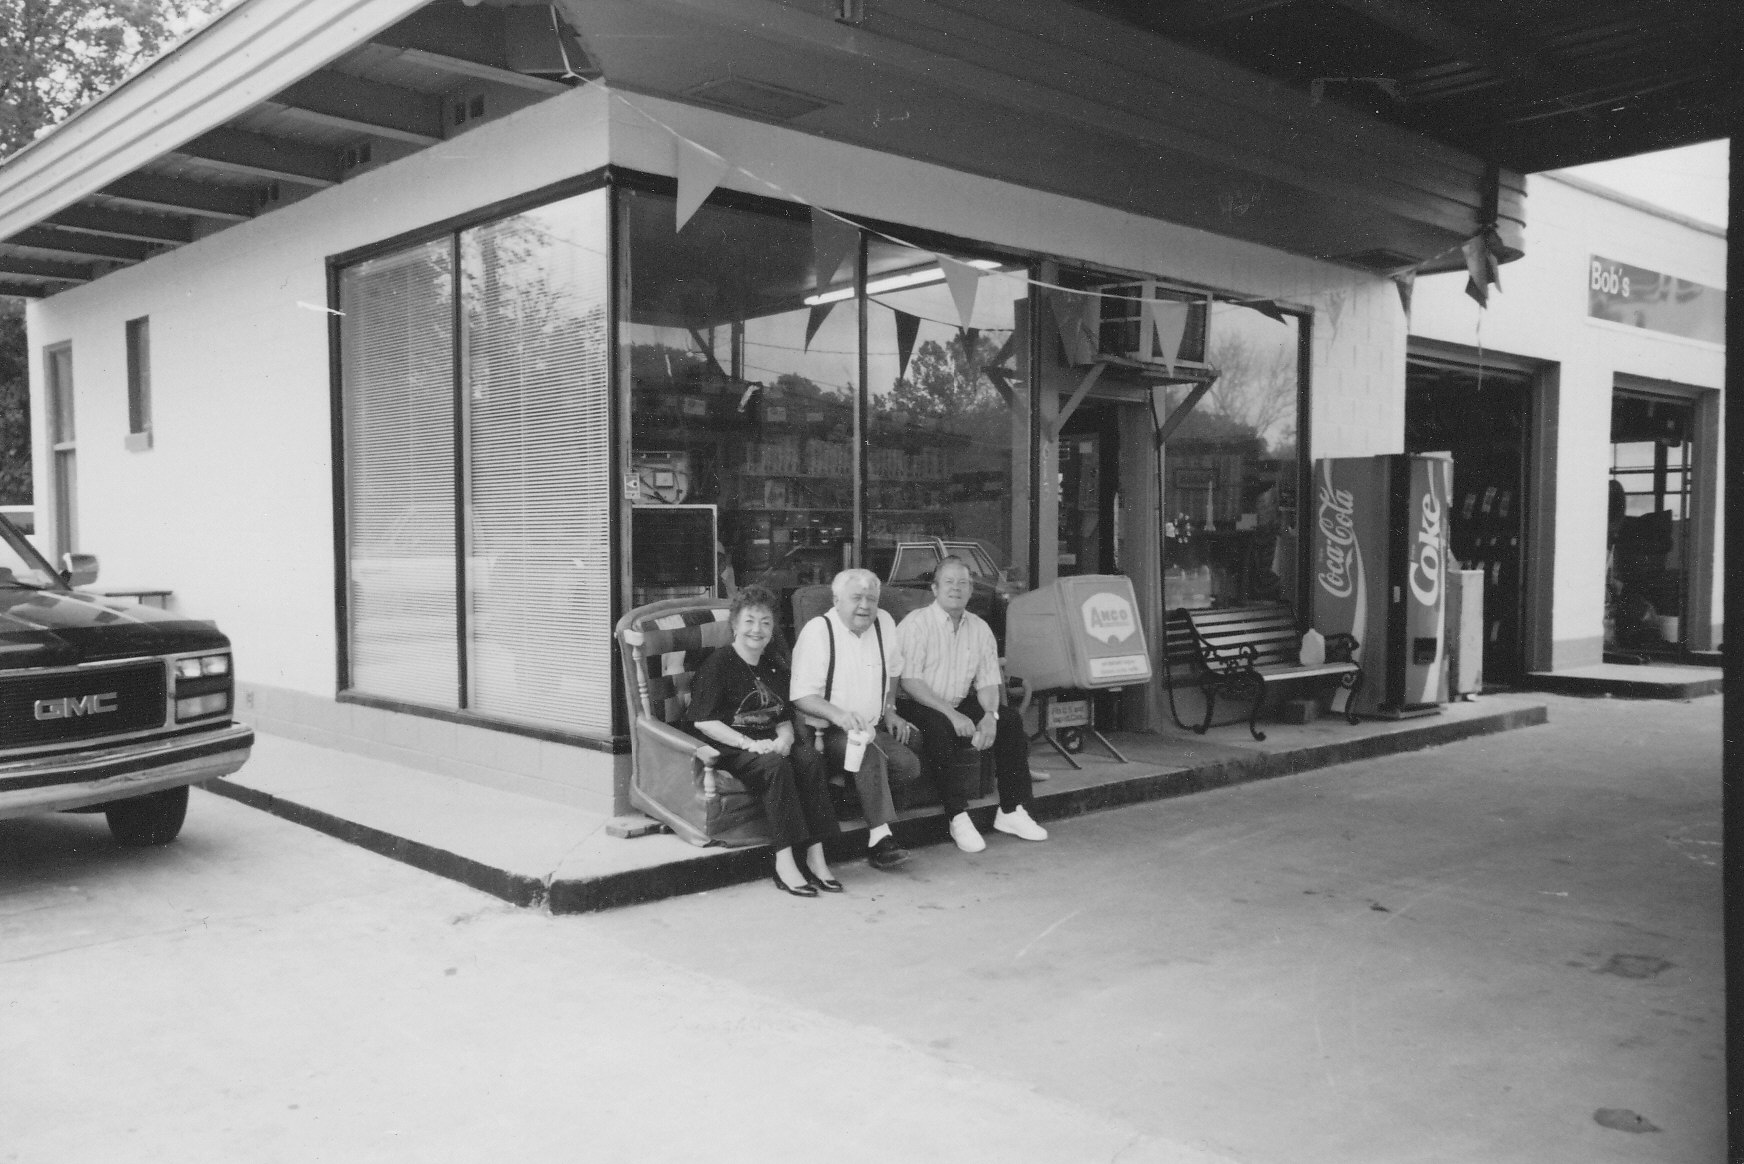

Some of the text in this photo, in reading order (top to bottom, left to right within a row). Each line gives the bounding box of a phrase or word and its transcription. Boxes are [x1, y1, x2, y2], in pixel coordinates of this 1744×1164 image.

[1591, 261, 1631, 298] Bob's
[1318, 486, 1354, 598] Coca-Cola
[1409, 493, 1441, 606] Coke
[34, 692, 118, 720] GMC
